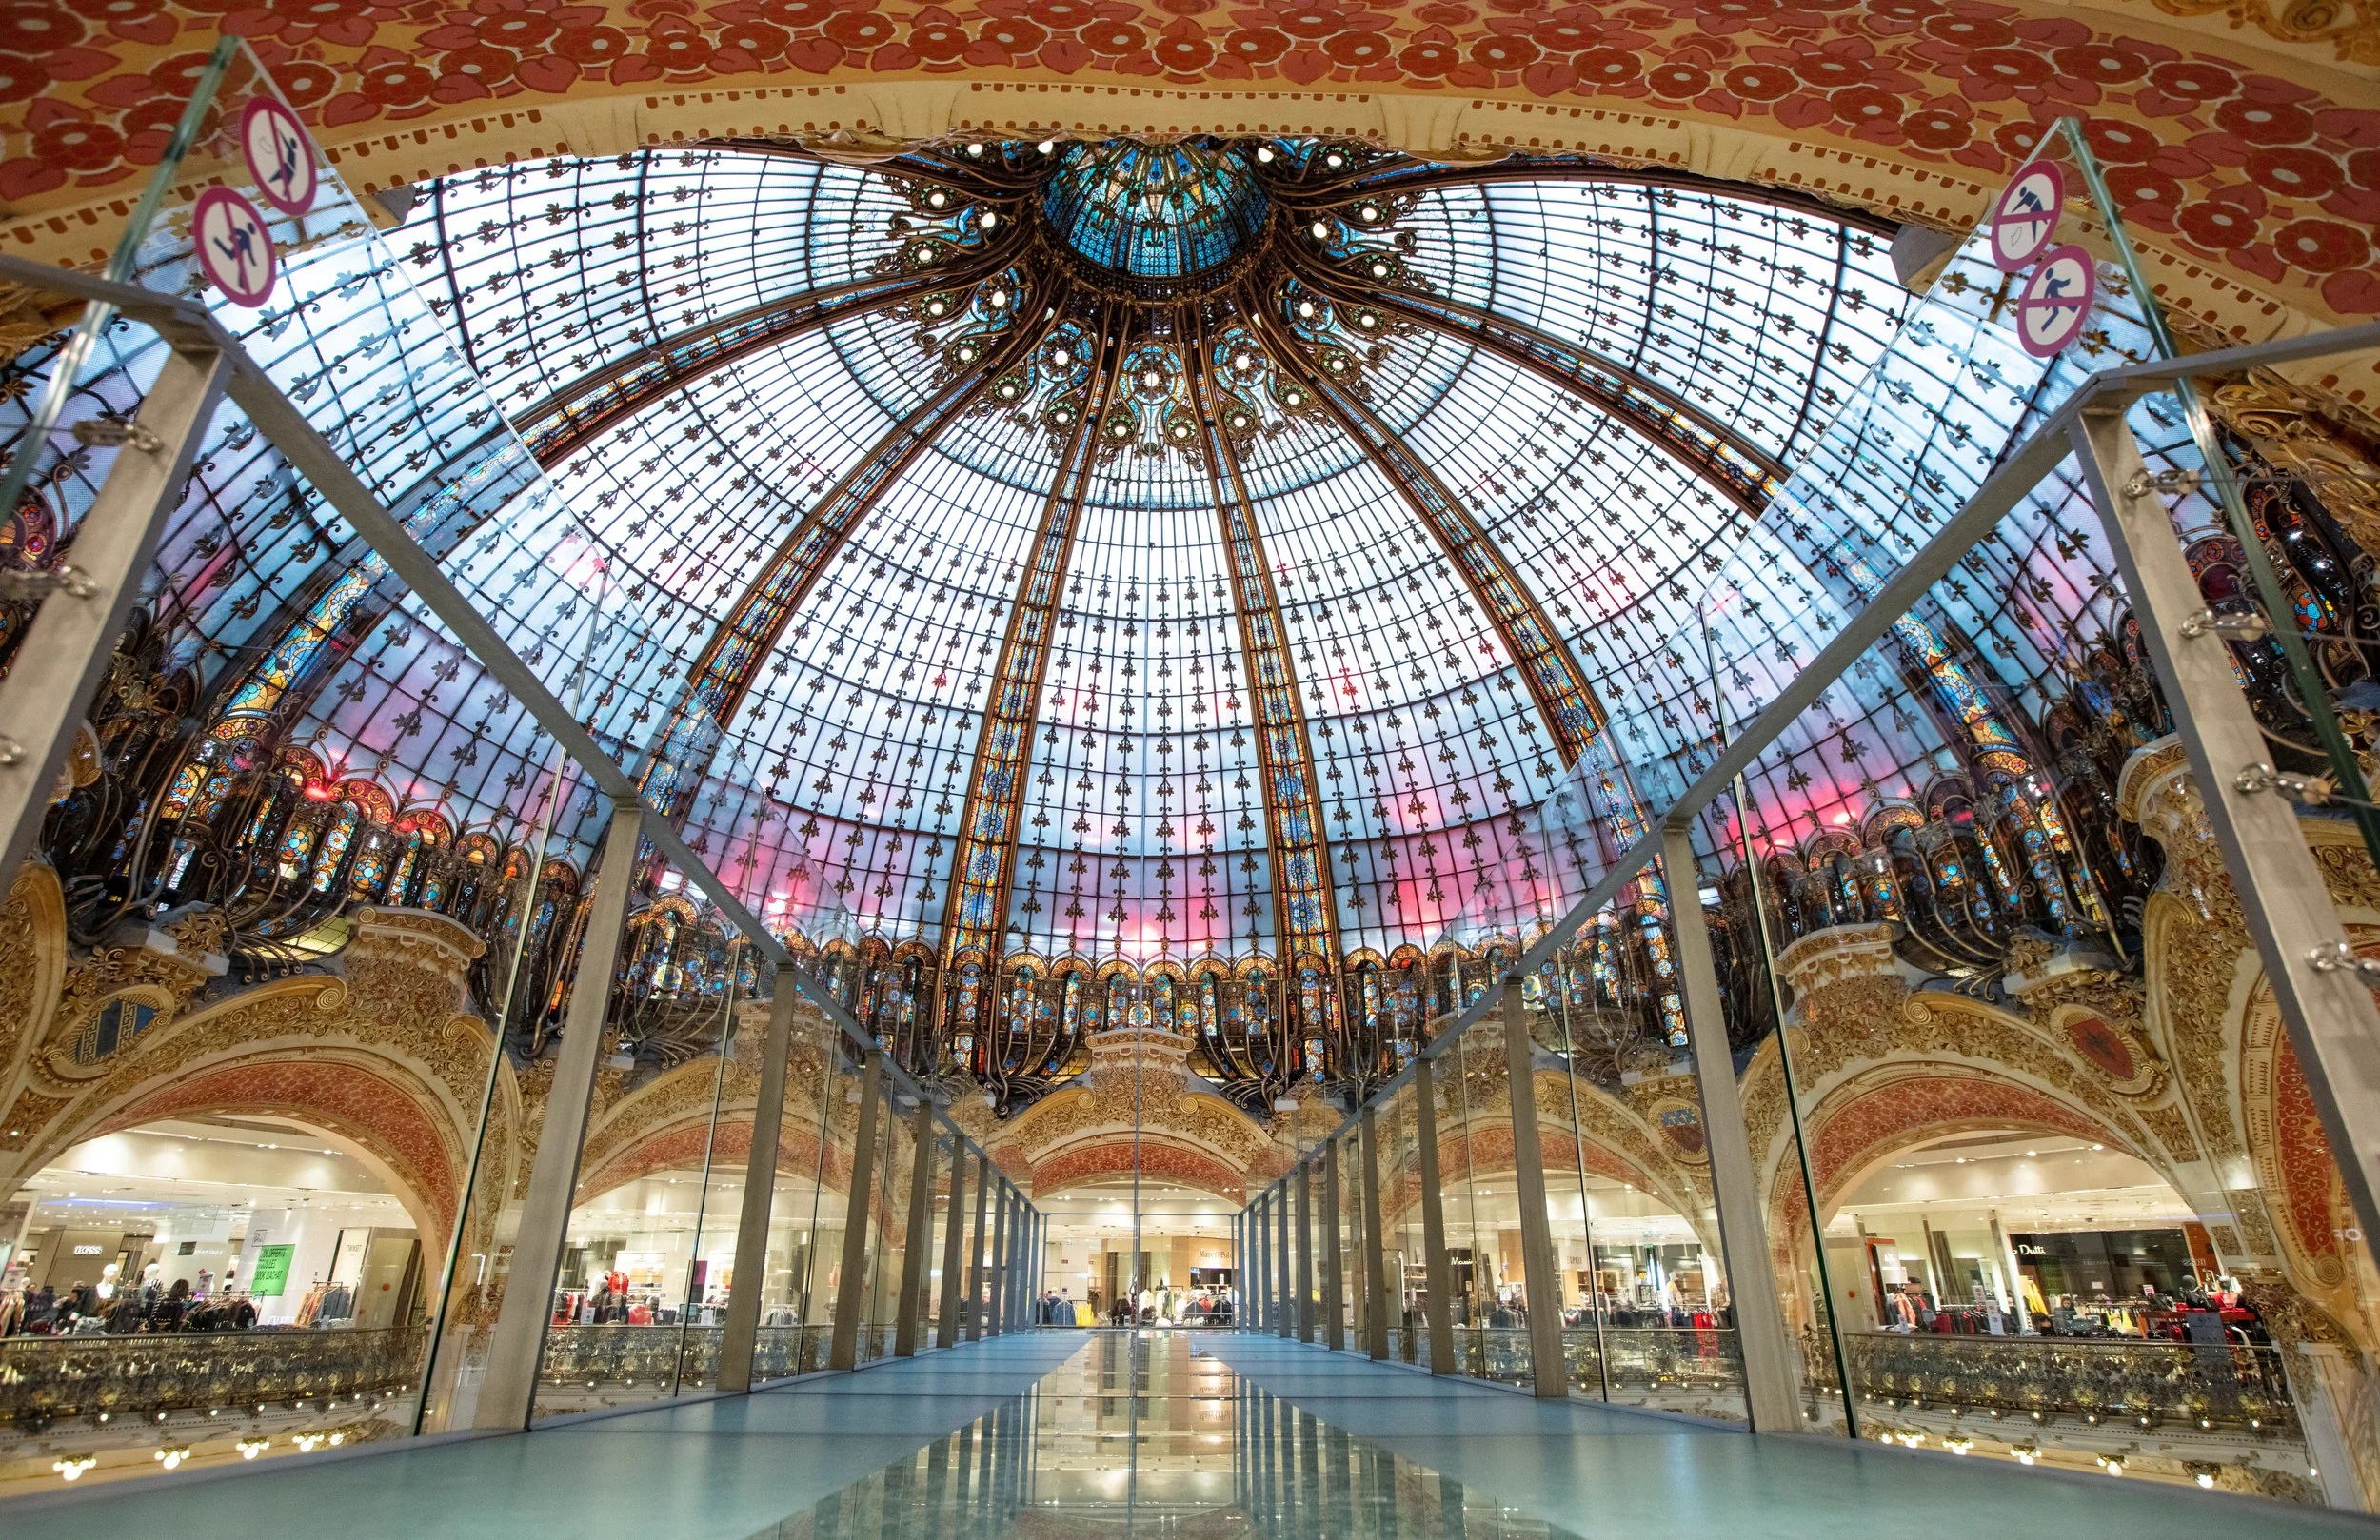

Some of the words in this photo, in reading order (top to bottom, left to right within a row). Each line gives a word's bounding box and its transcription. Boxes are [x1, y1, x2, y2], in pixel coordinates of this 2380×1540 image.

[73, 1245, 103, 1255] BOSS
[2018, 1244, 2047, 1255] Dutti
[1567, 1256, 1582, 1265] ESPRIT
